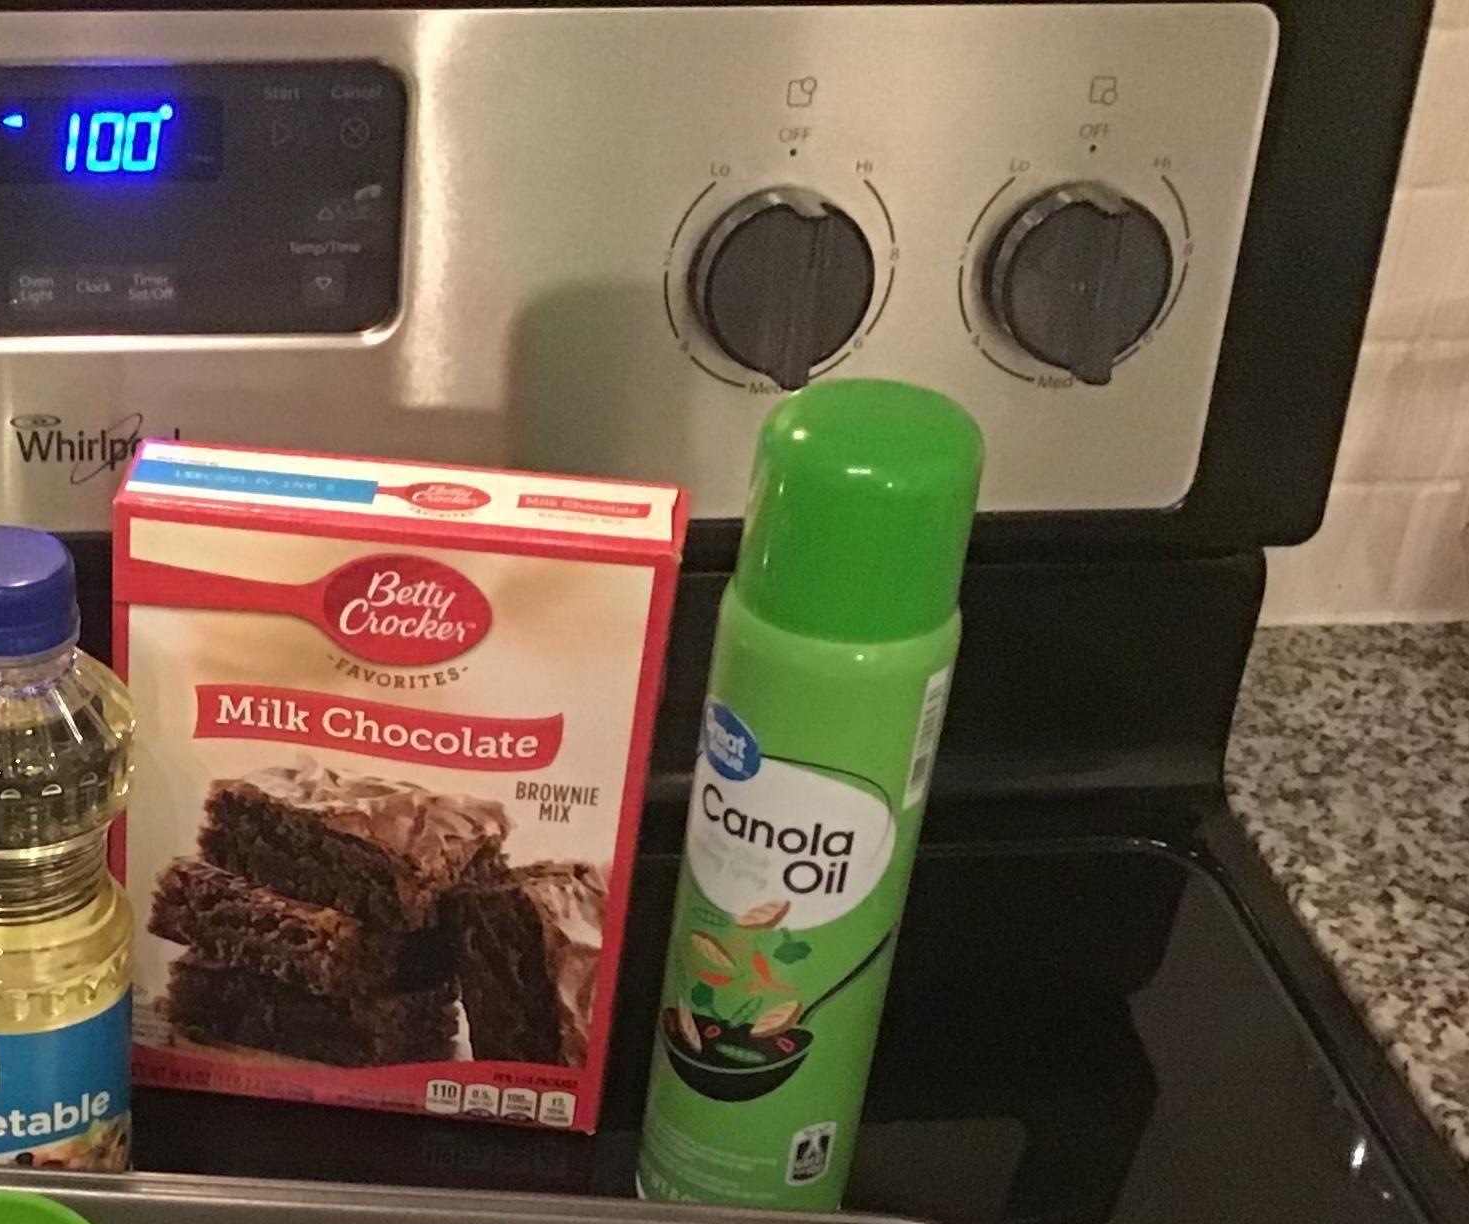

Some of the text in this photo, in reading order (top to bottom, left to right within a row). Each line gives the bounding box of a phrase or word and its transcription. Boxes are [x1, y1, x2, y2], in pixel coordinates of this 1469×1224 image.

[778, 127, 812, 143] OFF
[1079, 123, 1111, 139] OFF
[710, 163, 731, 177] Lo
[856, 159, 873, 174] Hi
[1009, 158, 1030, 173] Lo
[1154, 156, 1172, 170] Hi
[75, 281, 112, 294] Clock
[1037, 374, 1075, 388] Med
[17, 428, 180, 470] Whirlp
[367, 571, 456, 610] Betty
[339, 598, 467, 642] Crocker
[216, 694, 539, 760] Milk Chocolate
[515, 781, 600, 807] BROWNIE
[539, 804, 572, 823] MIX
[702, 783, 855, 857] Canola
[782, 860, 849, 895] Oil
[431, 1083, 458, 1098] 110
